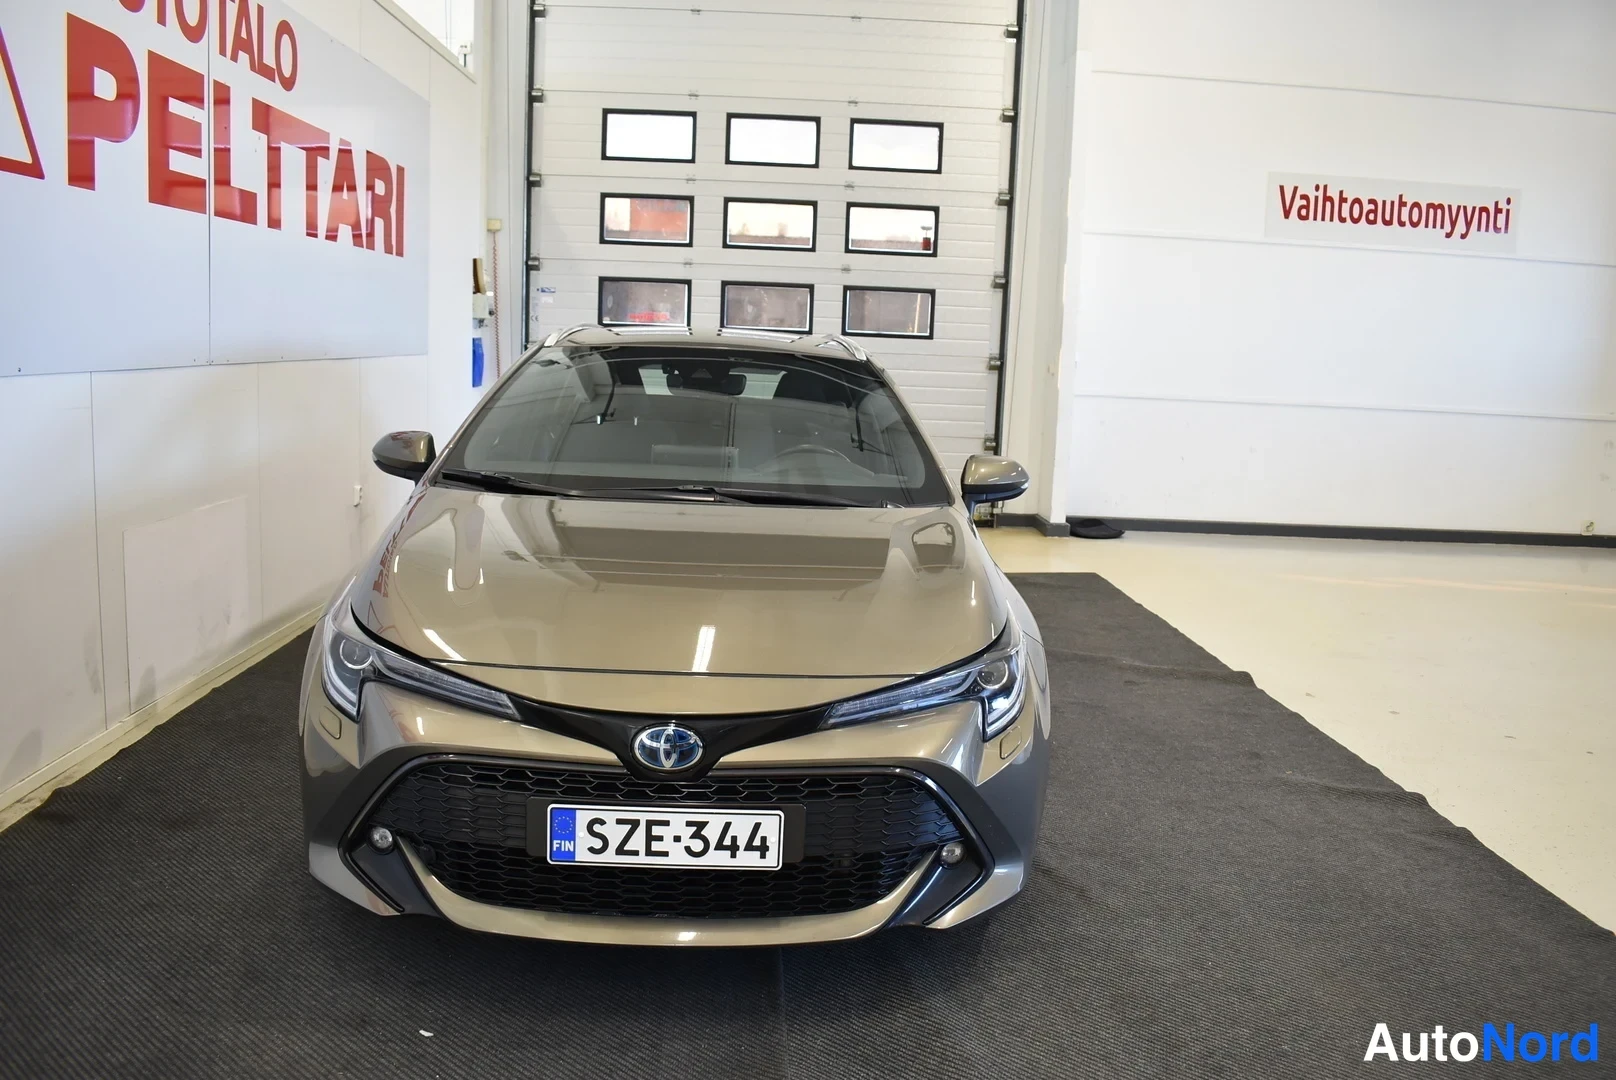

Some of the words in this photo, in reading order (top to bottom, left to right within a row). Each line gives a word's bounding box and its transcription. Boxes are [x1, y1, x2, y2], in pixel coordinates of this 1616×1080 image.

[66, 12, 405, 258] PELTTARI
[1279, 183, 1512, 240] Vaihtoautomyynti
[553, 840, 574, 852] FIN
[586, 817, 770, 860] SZE-344
